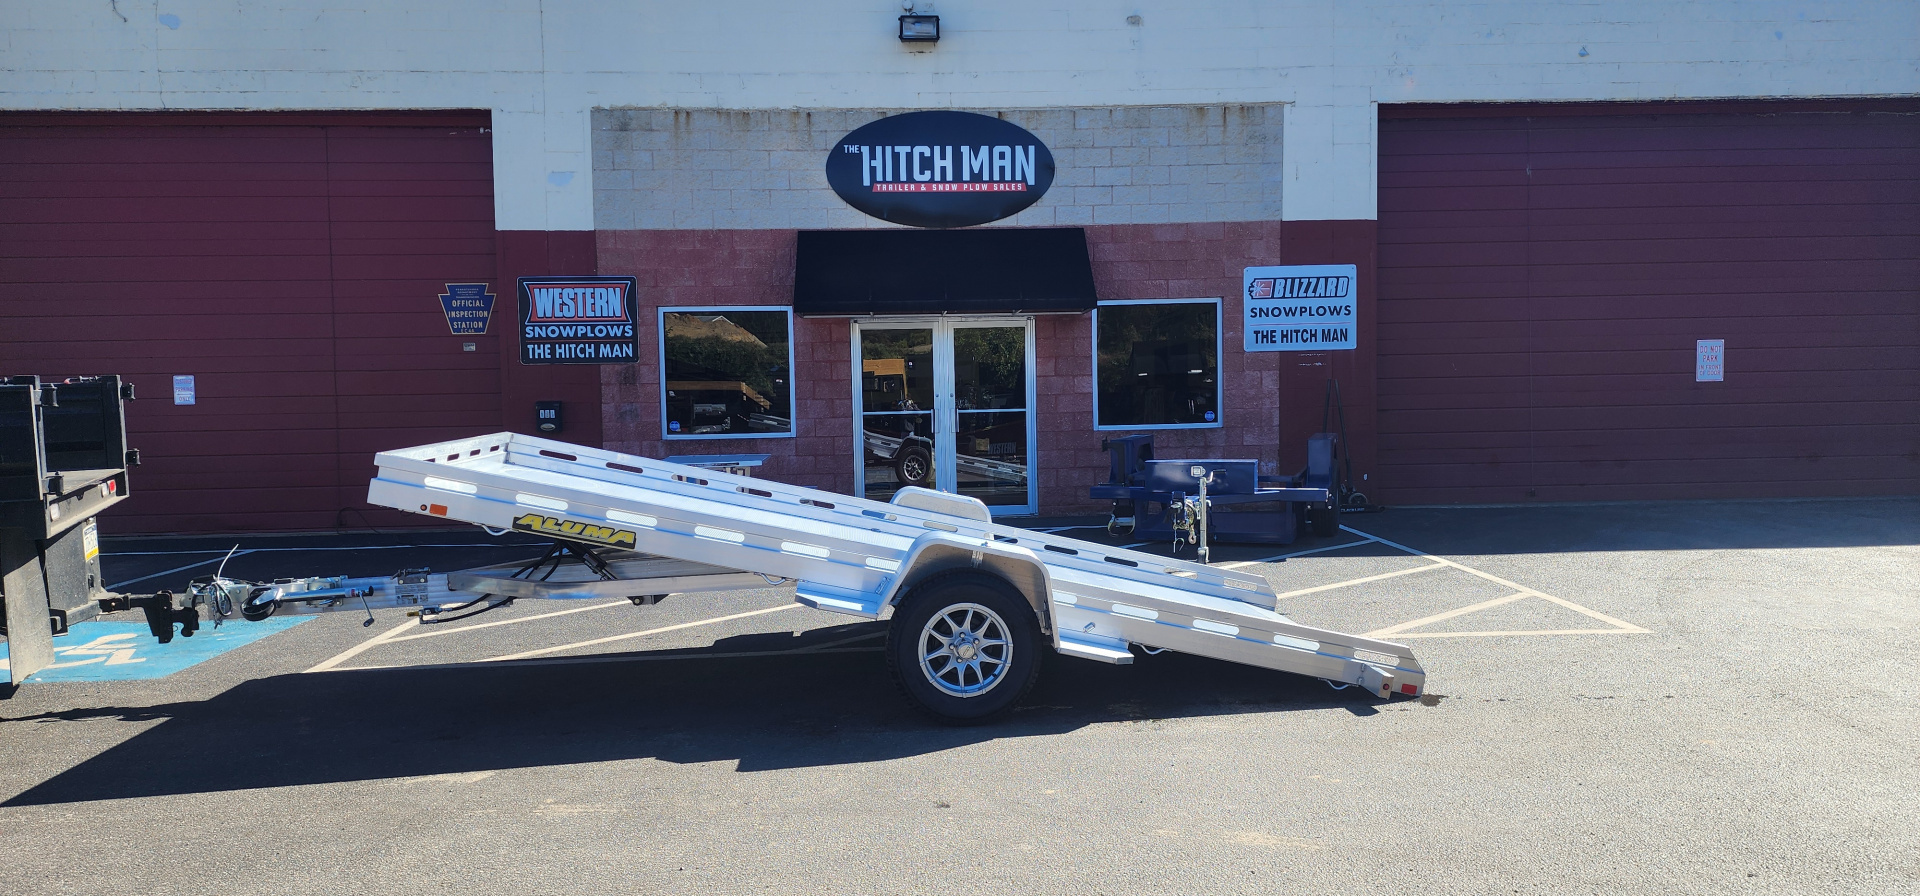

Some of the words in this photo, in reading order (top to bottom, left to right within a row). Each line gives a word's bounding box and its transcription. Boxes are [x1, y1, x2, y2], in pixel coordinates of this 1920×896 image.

[843, 144, 860, 154] THE
[861, 145, 953, 186] HITCH
[961, 145, 1036, 186] MAN
[876, 183, 916, 191] TRAILER
[920, 183, 927, 191] &
[932, 183, 958, 191] SNOW
[963, 183, 988, 191] PLOW
[993, 183, 1023, 191] SALES
[1273, 277, 1349, 298] BLIZZARD
[451, 299, 485, 307] OFFICIAL
[533, 287, 622, 318] WESTERN
[448, 310, 488, 318] INSPECTION
[1250, 305, 1351, 318] SNOWPLOWS
[453, 321, 483, 329] STATION
[525, 325, 633, 338] SNOWPLOWS
[1253, 329, 1277, 344] THE
[1281, 329, 1317, 344] HITCH
[1322, 328, 1348, 343] MAN
[527, 344, 551, 359] THE
[555, 343, 595, 359] HITCH
[599, 343, 633, 358] MAN
[1700, 345, 1708, 353] DO
[1710, 345, 1721, 353] NOT
[988, 442, 1017, 455] WESTERN
[515, 513, 636, 544] ALUMA
